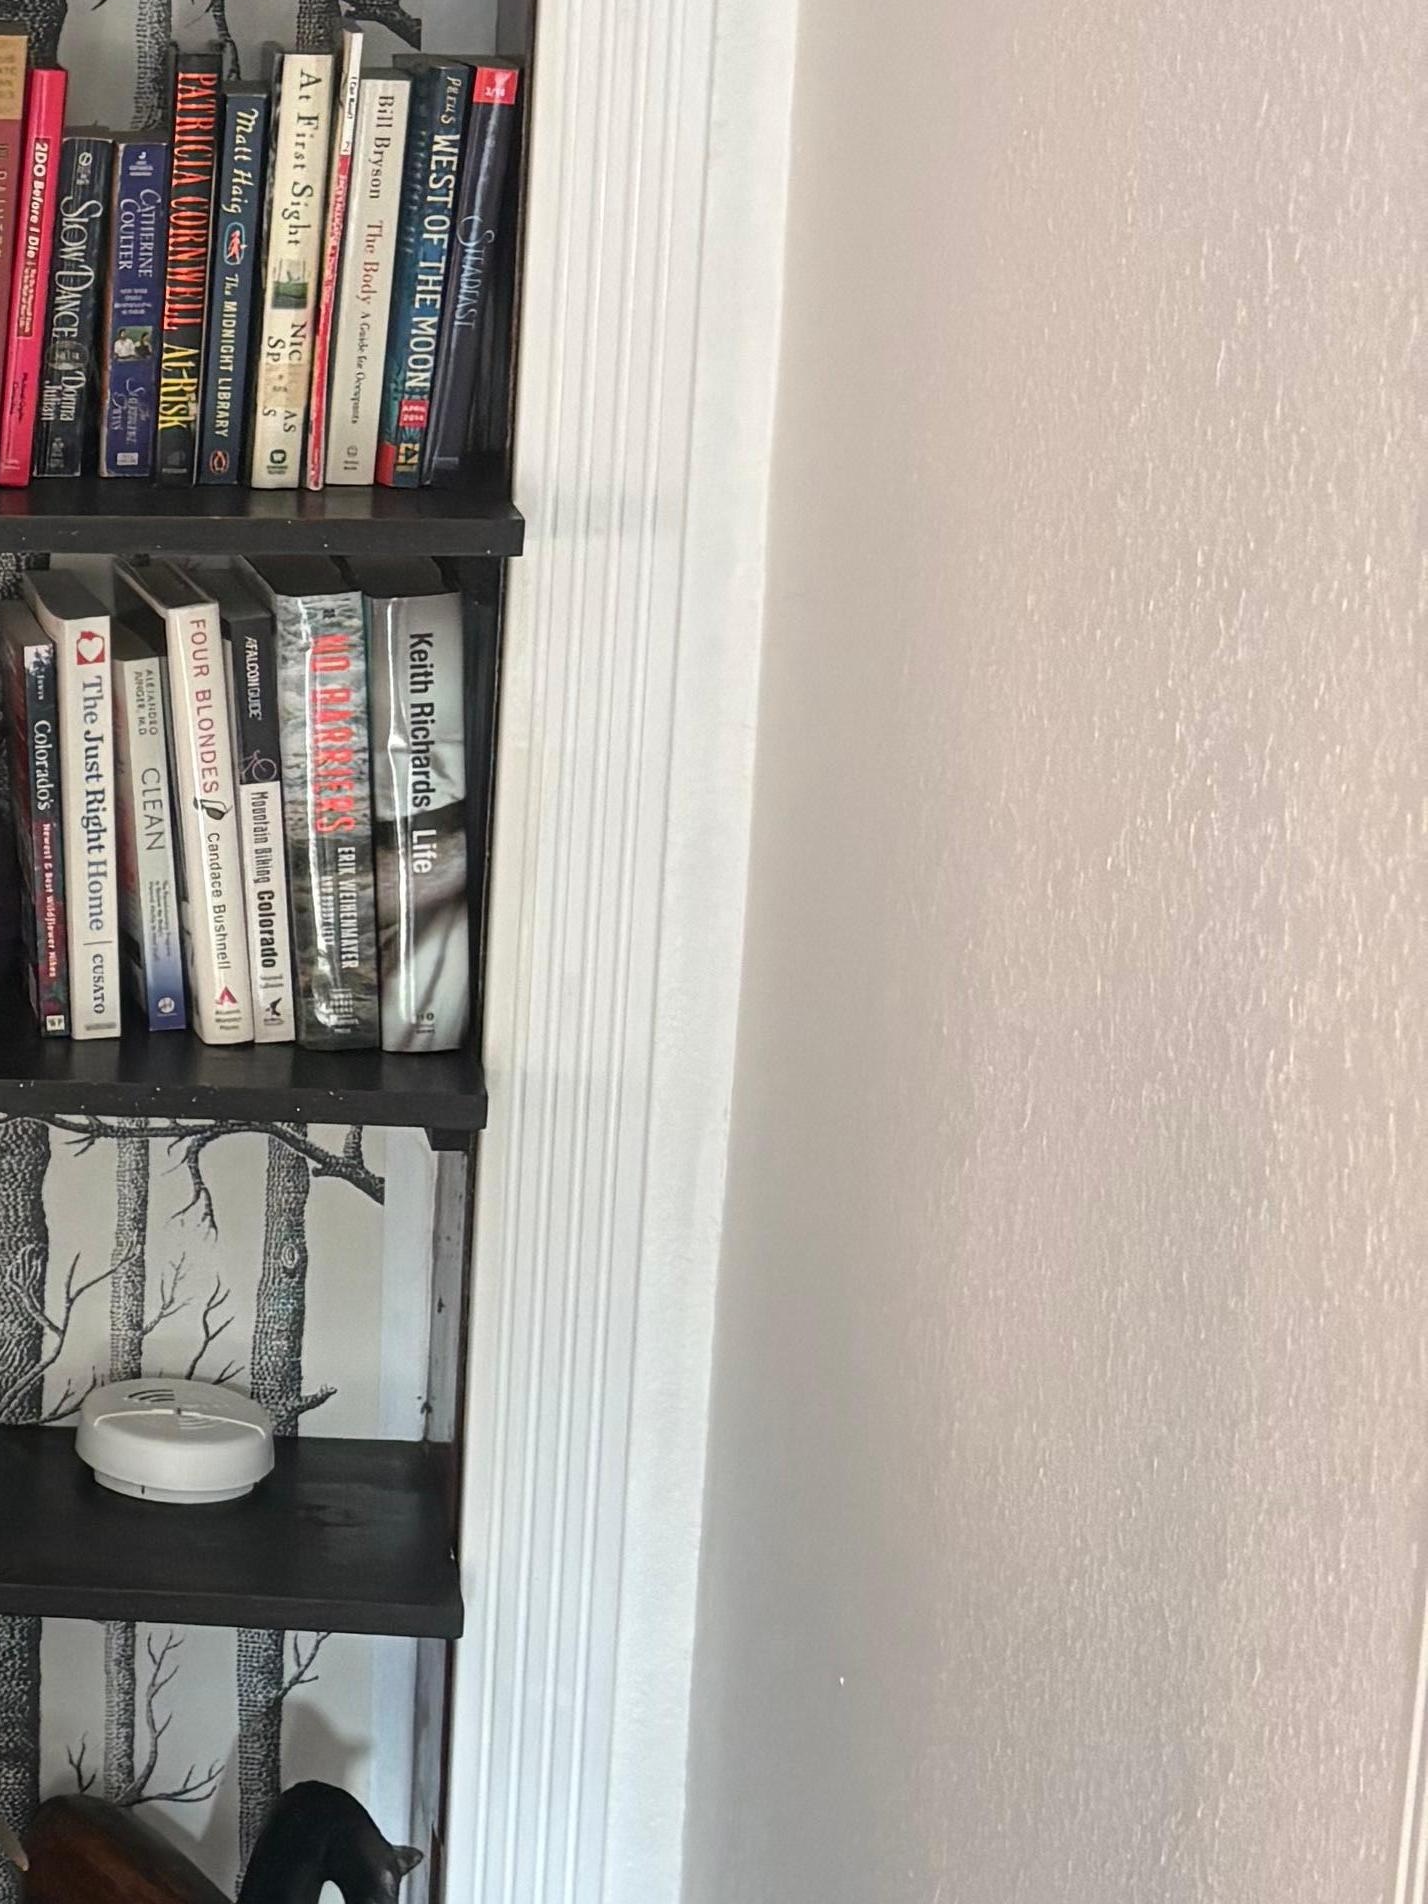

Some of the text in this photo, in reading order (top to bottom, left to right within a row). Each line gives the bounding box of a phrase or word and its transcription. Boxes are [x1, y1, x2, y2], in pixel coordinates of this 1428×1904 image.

[33, 142, 49, 177] 2DO
[220, 107, 260, 215] Matt Haig
[281, 68, 323, 246] At First Sight
[368, 95, 395, 200] Bill Bryson
[29, 179, 45, 224] Before
[117, 197, 142, 271] COULTER
[137, 188, 162, 279] CATHERINE
[163, 71, 218, 331] PATRICIA CORNWELL
[366, 220, 384, 255] The
[26, 235, 40, 259] Die
[355, 260, 380, 304] Body
[404, 133, 462, 392] WEST OF THE MOON
[51, 262, 95, 338] DANCE
[59, 369, 87, 422] Donna
[214, 273, 239, 438] The MIDNIGHT LIBRARY
[189, 618, 220, 794] FOUR BLONDES
[311, 633, 356, 834] NO BARRIERS
[33, 719, 55, 811] Colorado's
[408, 632, 438, 874] Keith Richards Life
[80, 674, 108, 932] The Just Right Home
[140, 766, 166, 852] CLEAN
[250, 790, 270, 844] Mountain
[206, 832, 232, 971] Candace Bushnell
[253, 847, 273, 884] Biking
[337, 846, 357, 876] ERIK
[45, 895, 57, 949] Wildflower
[256, 889, 279, 969] Colorado
[338, 877, 360, 969] WEIHENMAYER
[91, 953, 105, 1015] CUSATO
